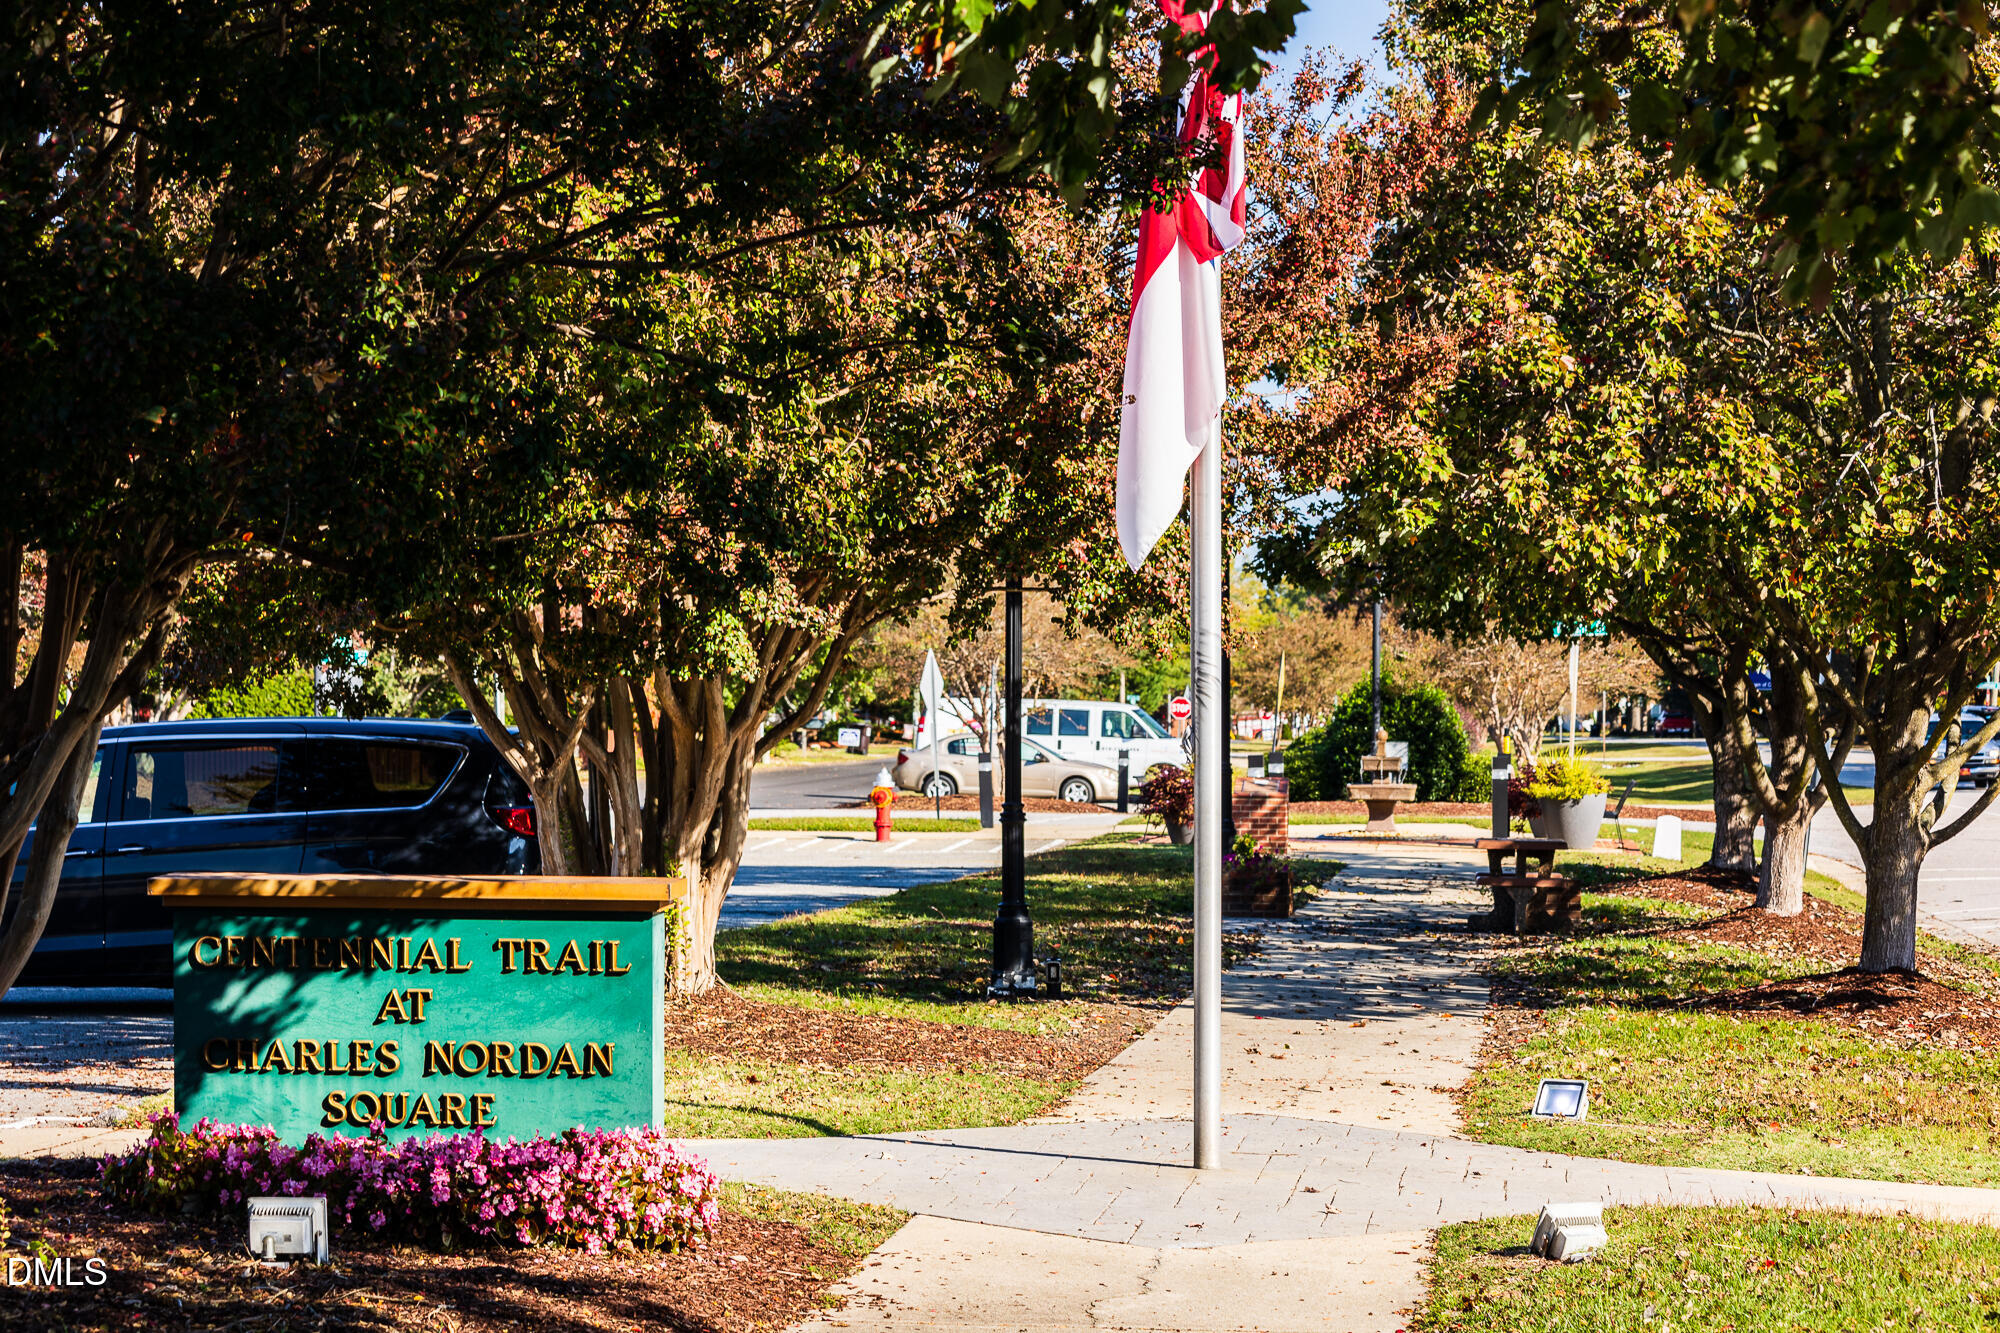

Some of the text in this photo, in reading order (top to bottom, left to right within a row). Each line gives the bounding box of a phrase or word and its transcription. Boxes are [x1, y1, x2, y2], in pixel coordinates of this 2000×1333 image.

[1171, 702, 1190, 713] STOP
[193, 935, 632, 974] CENTENNIAL TRAIL
[378, 988, 433, 1023] AT
[203, 1038, 616, 1077] CHARLES NORDAN
[324, 1090, 499, 1127] SQUARE
